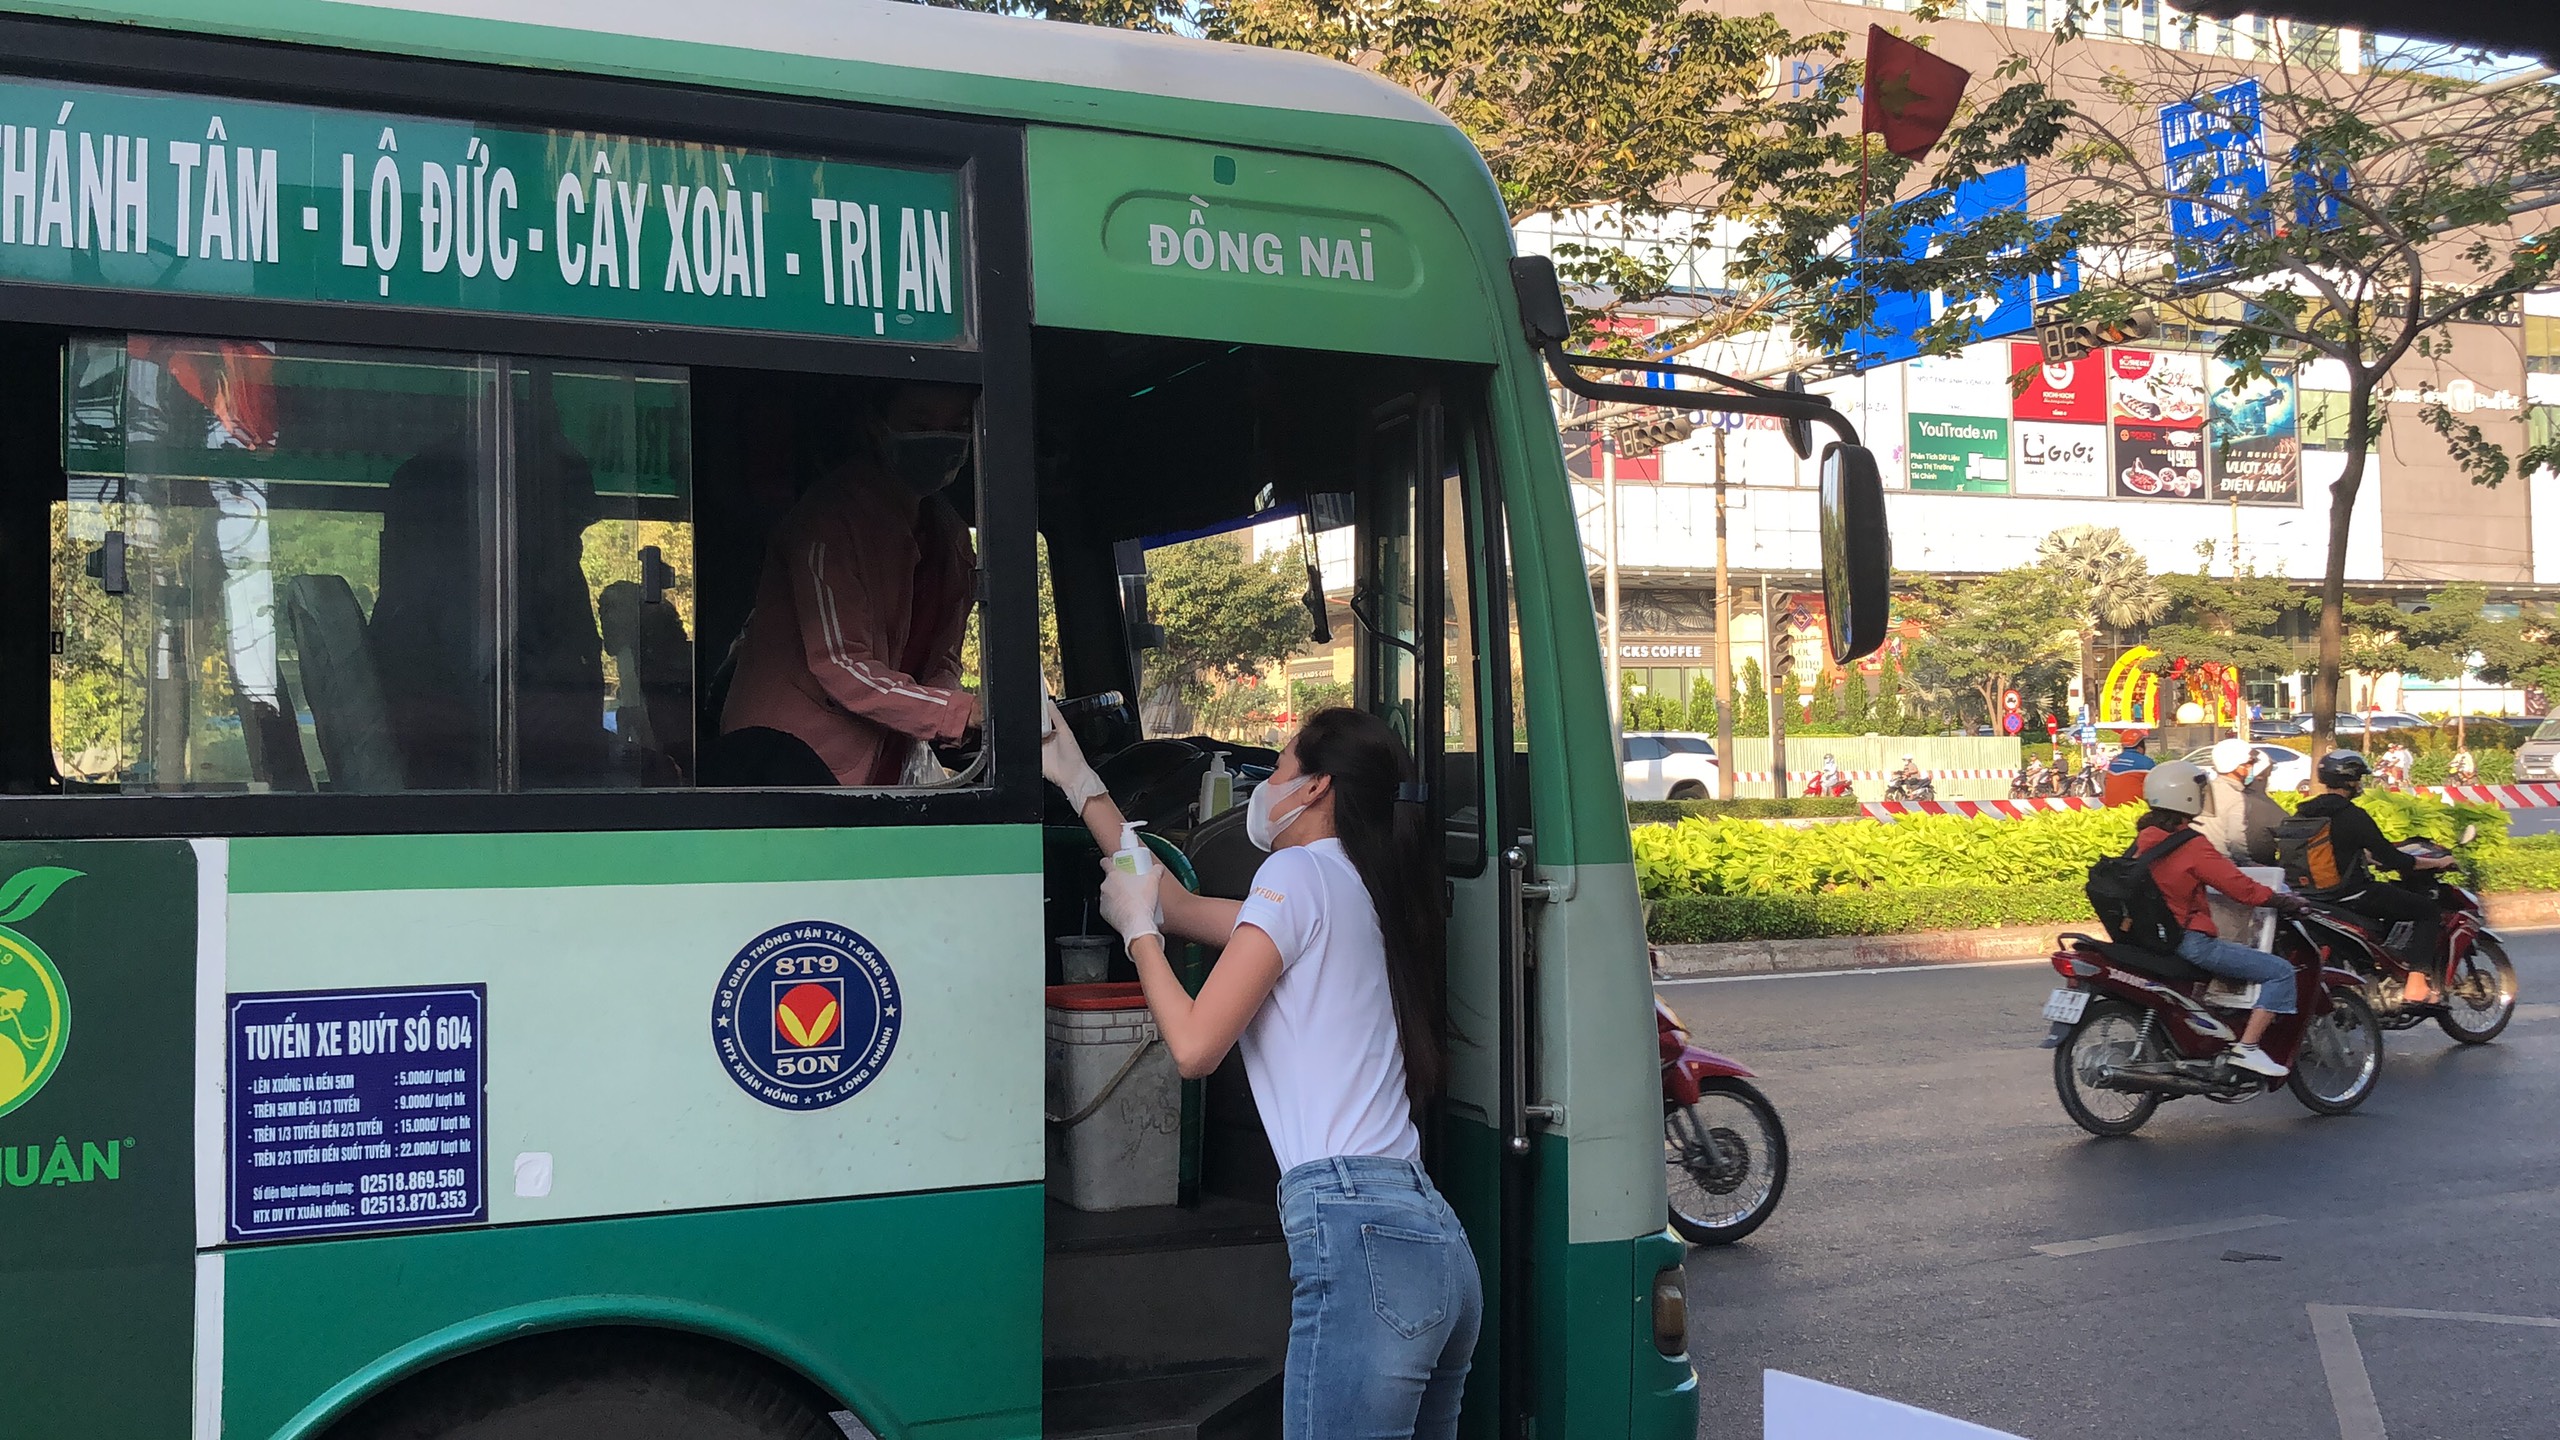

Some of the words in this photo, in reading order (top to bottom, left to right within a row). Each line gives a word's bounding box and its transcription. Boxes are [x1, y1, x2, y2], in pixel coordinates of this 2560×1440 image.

[0, 101, 149, 254] HÁNH
[169, 115, 279, 263] TÂM
[342, 127, 402, 297] LỘ
[420, 137, 518, 281] ĐỨC
[556, 151, 648, 290] CÂY
[662, 163, 766, 298] XOÀI
[811, 198, 885, 335] TRỊ
[898, 207, 952, 314] AN
[1148, 194, 1283, 275] ĐỒNG
[2484, 311, 2521, 325] OGA
[1918, 421, 1998, 440] YouTrade.vn
[2225, 461, 2260, 477] VƯỢT
[2264, 462, 2283, 475] XA
[2220, 478, 2254, 494] ĐIỆN
[1651, 646, 1702, 658] COFFEE
[1254, 886, 1285, 904] YFOUR
[728, 958, 750, 987] GIAO
[749, 932, 792, 960] THÔNG
[795, 926, 821, 940] VẬN
[825, 930, 845, 944] TẢI
[879, 977, 892, 999] NAI
[775, 955, 839, 975] 8T9
[245, 1012, 310, 1061] TUYẾN
[316, 1021, 342, 1056] XE
[349, 1012, 398, 1055] BUÝT
[404, 1005, 430, 1052] SỐ
[436, 1016, 472, 1050] 604
[722, 1037, 734, 1063] HTX
[733, 1061, 762, 1091] XUÂN
[839, 1069, 870, 1095] LONG
[868, 1027, 893, 1068] KHÁNH
[254, 1076, 270, 1094] LÊN
[272, 1072, 301, 1093] XUỐNG
[303, 1073, 314, 1091] VÀ
[316, 1071, 334, 1090] ĐẾN
[335, 1074, 354, 1089] 5KM
[454, 1068, 465, 1082] hk
[254, 1100, 275, 1118] TRÊN
[278, 1102, 296, 1117] 5KM
[299, 1096, 317, 1116] ĐẾN
[319, 1100, 331, 1115] 1/3
[333, 1094, 360, 1113] TUYẾN
[454, 1092, 466, 1106] hk
[254, 1125, 276, 1143] TRÊN
[278, 1126, 291, 1141] 1/3
[293, 1120, 320, 1140] TUYẾN
[322, 1119, 339, 1139] ĐẾN
[341, 1122, 354, 1137] 2/3
[356, 1116, 383, 1136] TUYẾN
[460, 1115, 471, 1129] hk
[0, 1135, 120, 1187] UẬN
[254, 1149, 276, 1167] TRÊN
[278, 1151, 291, 1166] 2/3
[293, 1144, 320, 1165] TUYẾN
[322, 1143, 339, 1163] ĐẾN
[341, 1141, 363, 1161] SUỐT
[364, 1140, 391, 1159] TUYẾN
[460, 1139, 471, 1153] hk
[360, 1168, 465, 1194] 02518.869.560
[253, 1209, 270, 1223] HTX
[272, 1208, 283, 1221] DV
[285, 1207, 296, 1220] VT
[297, 1203, 322, 1220] XUÂN
[360, 1190, 467, 1216] 02513.870.353
